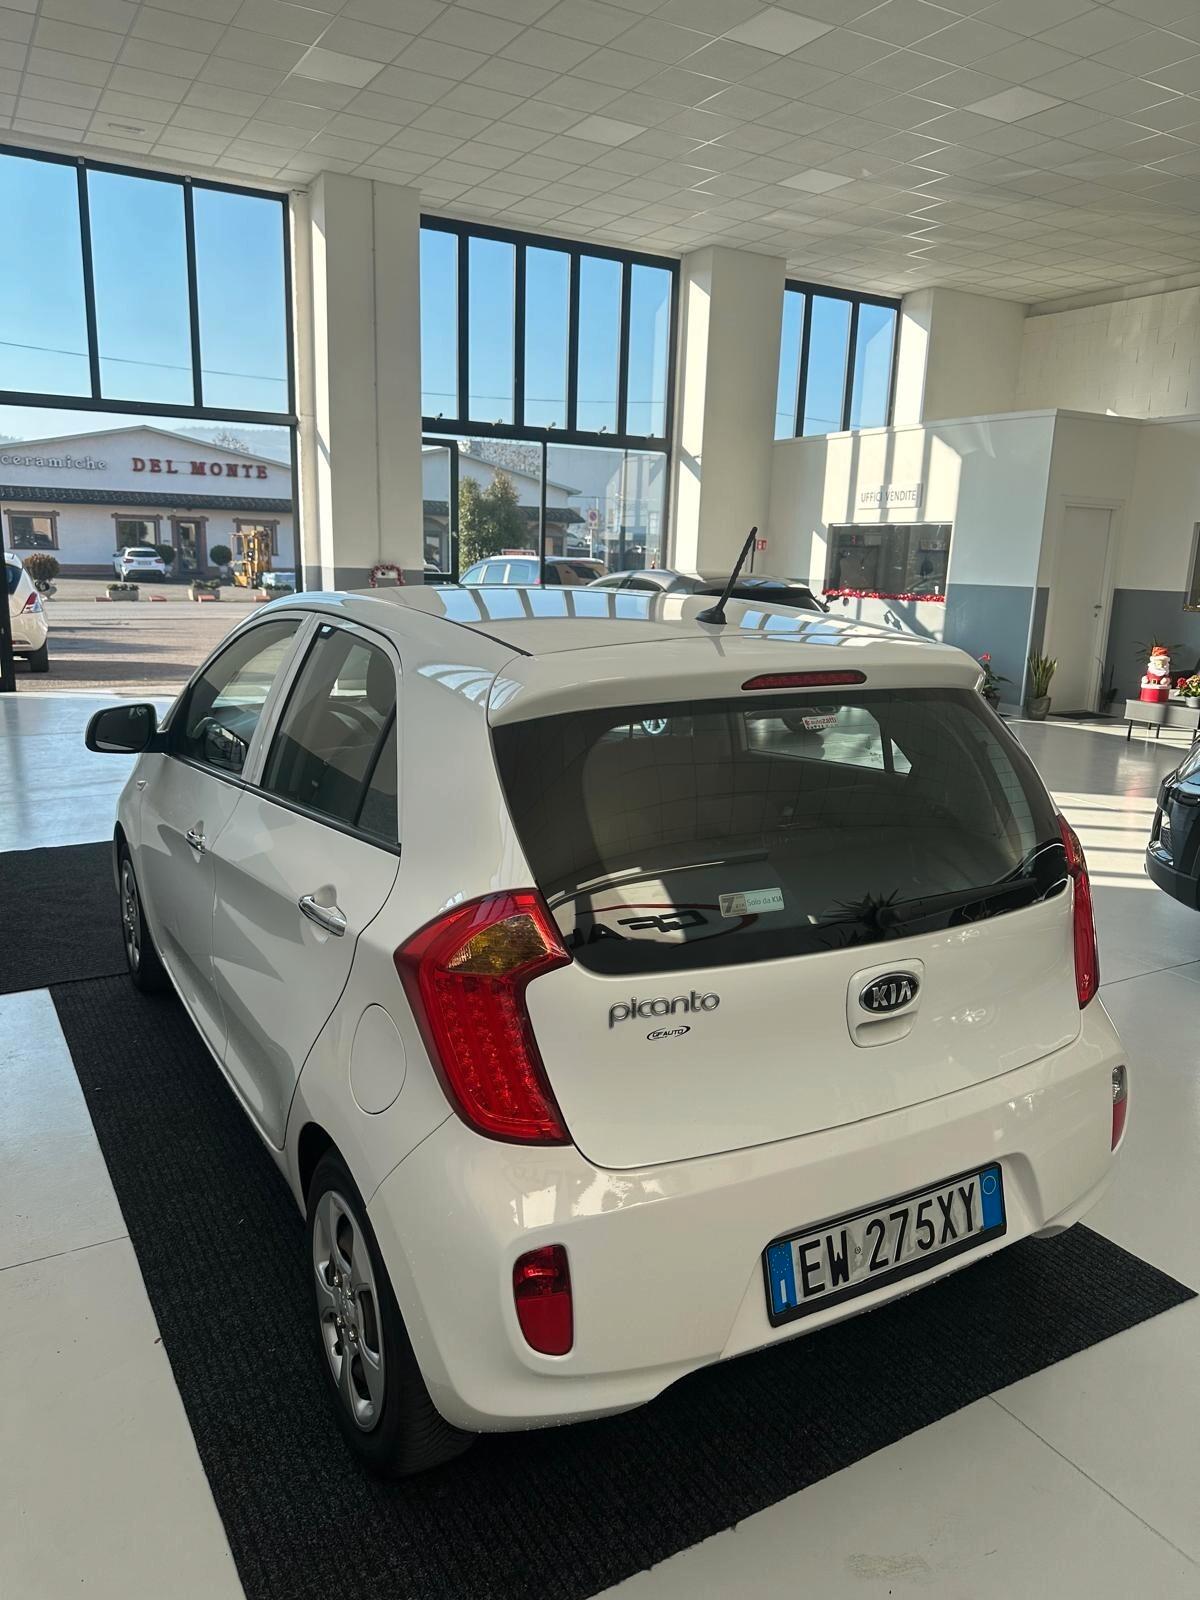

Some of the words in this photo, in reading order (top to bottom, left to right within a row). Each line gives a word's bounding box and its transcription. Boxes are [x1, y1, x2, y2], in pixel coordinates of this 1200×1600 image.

[0, 455, 107, 470] ceramiche
[131, 457, 178, 474] DEL
[190, 461, 268, 479] MONTE
[885, 490, 917, 502] VENDITE
[762, 897, 771, 905] da
[871, 980, 912, 1008] KIA
[608, 989, 720, 1029] picanto
[798, 1230, 850, 1298] EW
